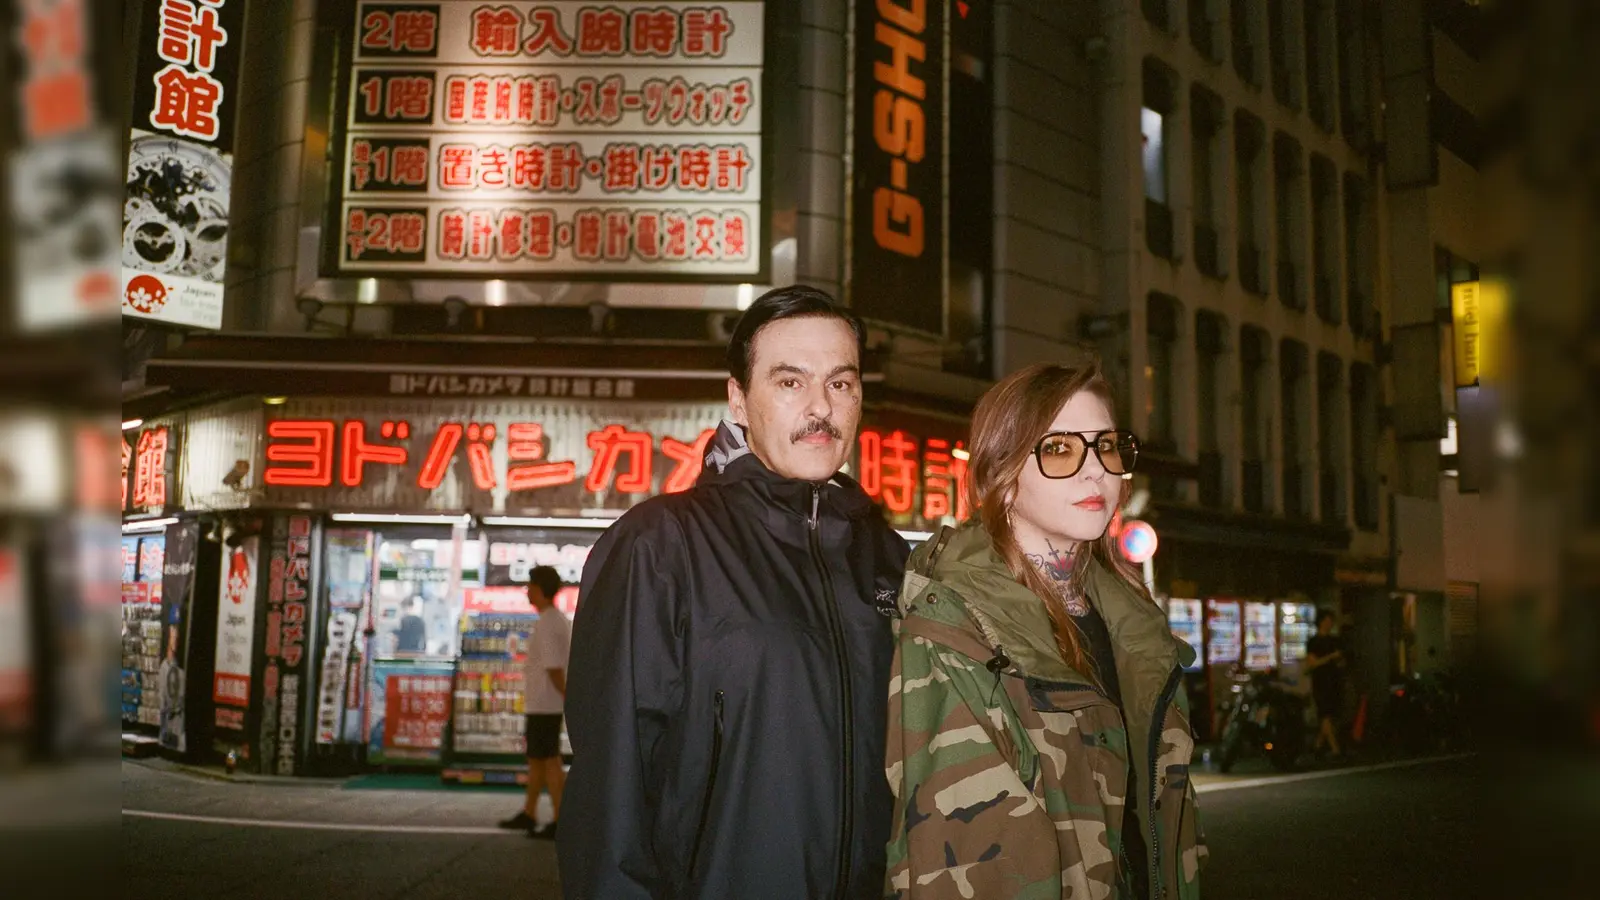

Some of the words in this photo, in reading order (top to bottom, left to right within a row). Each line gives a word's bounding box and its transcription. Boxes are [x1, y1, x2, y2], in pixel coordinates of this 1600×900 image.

[362, 9, 436, 51] 2階
[470, 6, 734, 57] 輸入腕時計
[150, 0, 228, 141] 計館
[360, 76, 433, 119] 1階
[438, 142, 752, 193] 置き時計・掛け時計
